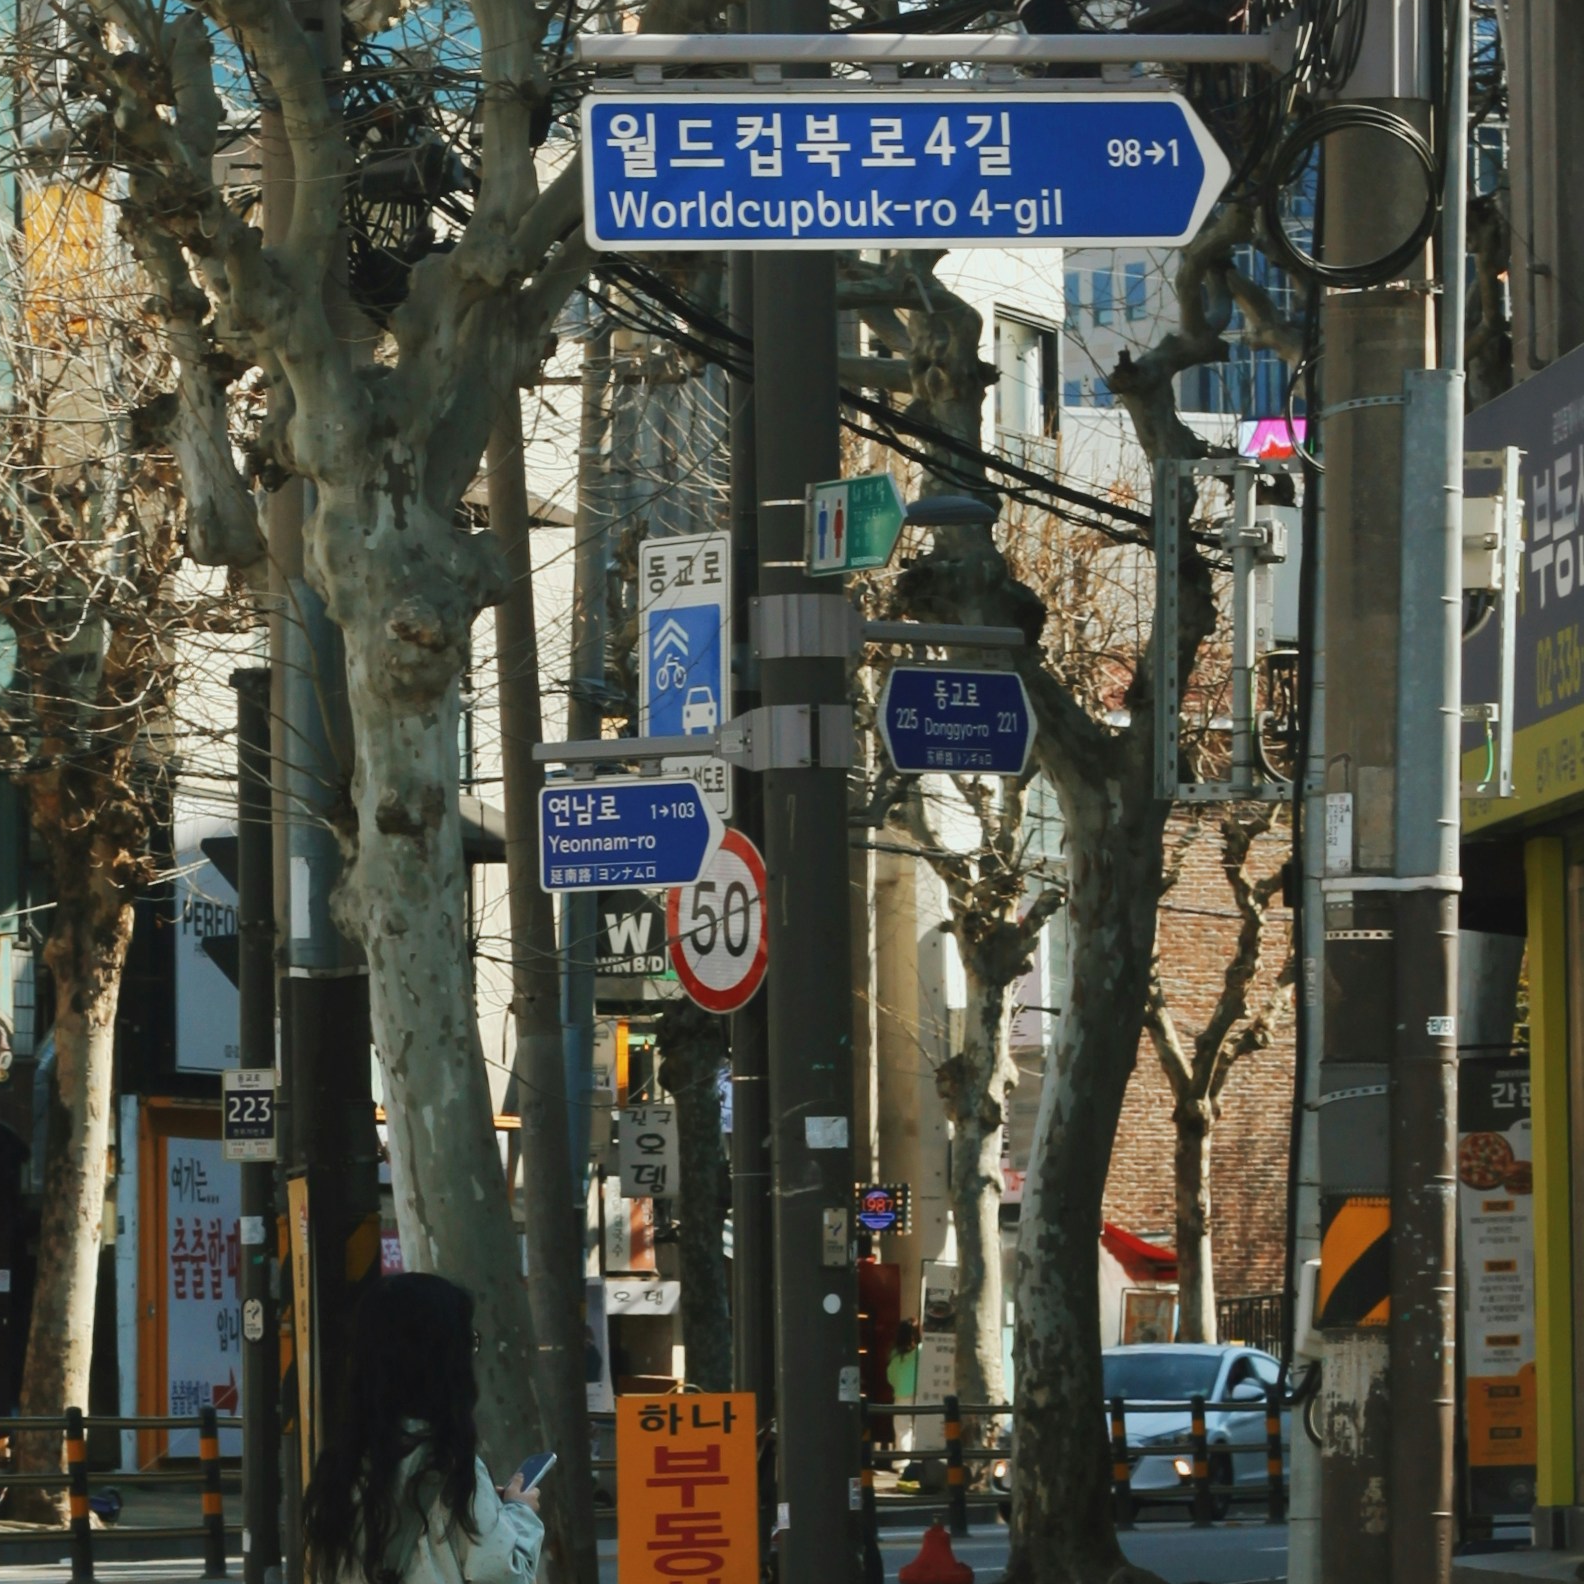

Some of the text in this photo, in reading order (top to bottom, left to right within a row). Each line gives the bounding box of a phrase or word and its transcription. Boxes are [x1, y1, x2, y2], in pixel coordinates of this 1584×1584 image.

[606, 111, 1013, 178] 월드컵북로4길
[609, 189, 1064, 236] Worldcupbuk-ro 4-gil
[647, 551, 722, 594] 동교로
[934, 680, 980, 710] 동교로
[896, 708, 1018, 740] 225 Donggyo-ro 221
[548, 794, 621, 827] 연남로
[548, 834, 656, 854] Yeonnam-ro
[550, 866, 656, 885] 延南路 ヨンナムロ
[182, 900, 240, 937] PERFO
[604, 912, 653, 954] W
[690, 881, 750, 957] 50
[633, 956, 664, 972] B/D
[228, 1097, 271, 1122] 223
[862, 1198, 894, 1213] 1987
[637, 1401, 738, 1436] 하나
